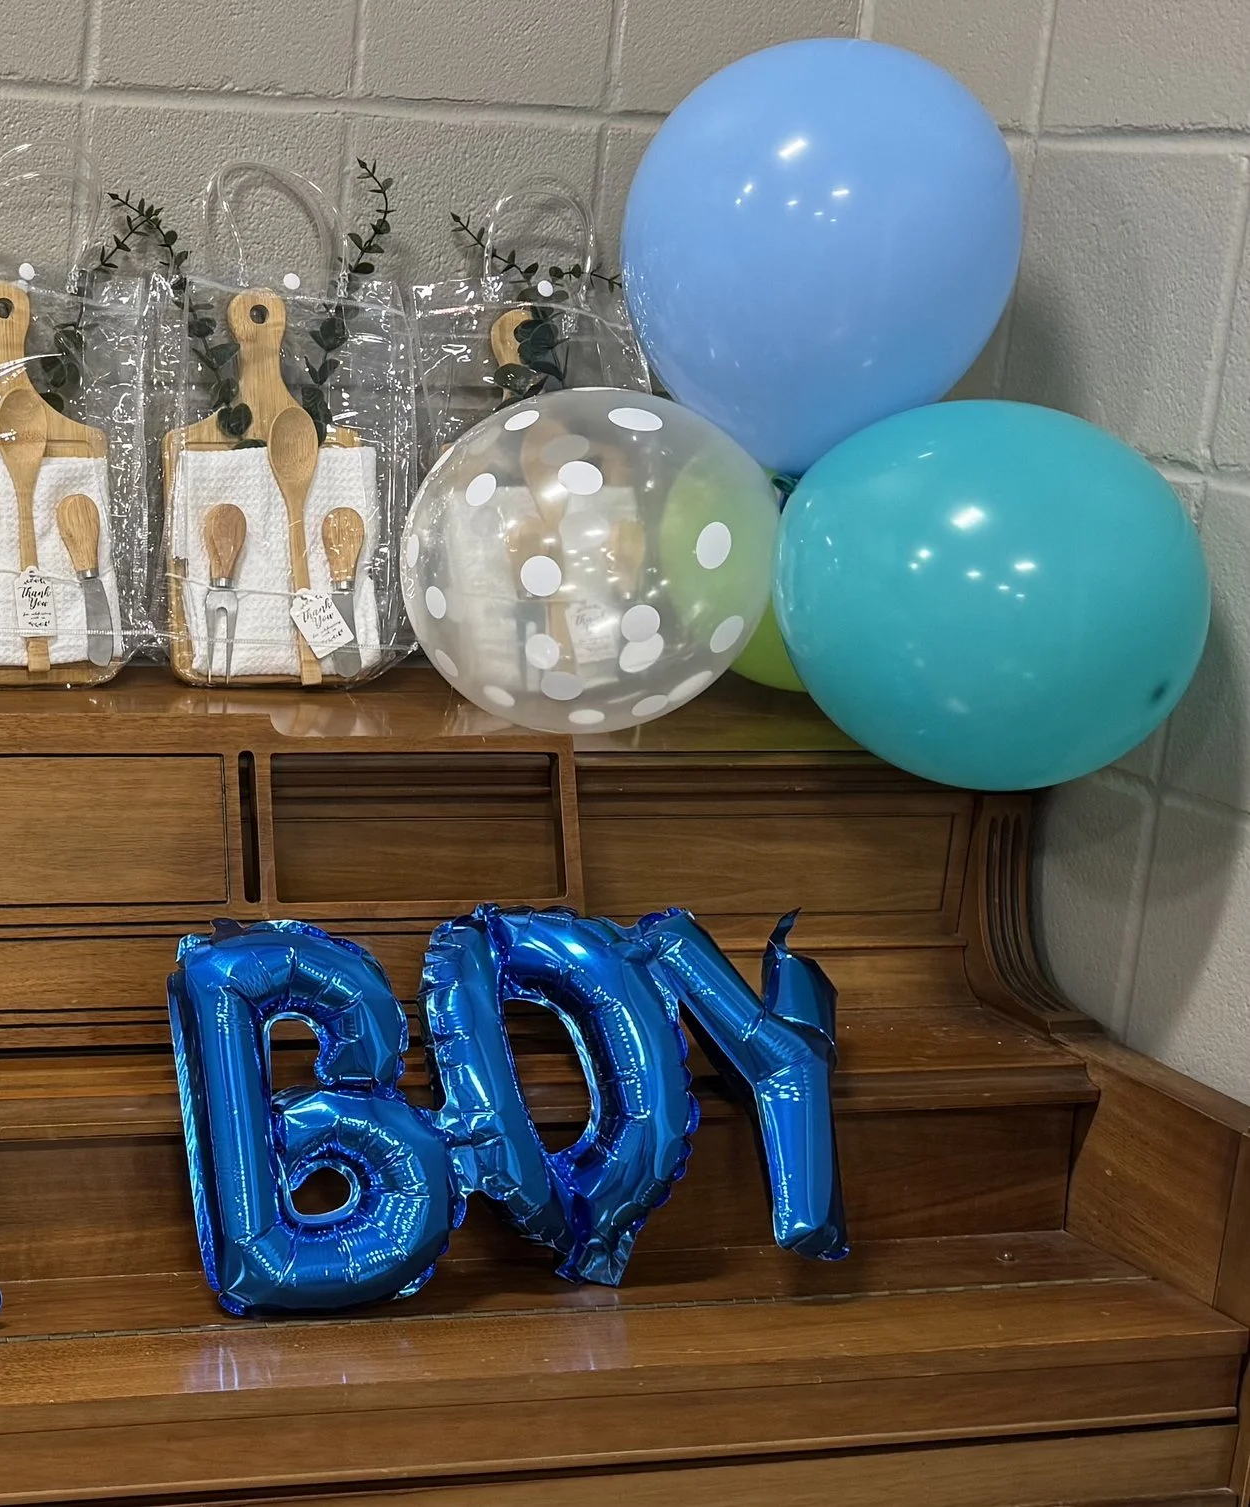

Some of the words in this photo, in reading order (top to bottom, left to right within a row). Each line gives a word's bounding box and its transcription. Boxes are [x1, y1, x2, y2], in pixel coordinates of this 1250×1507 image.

[17, 586, 51, 599] Thank
[29, 597, 48, 610] You
[297, 598, 332, 623] Thank
[314, 612, 334, 629] You
[167, 903, 850, 1316] BOY
